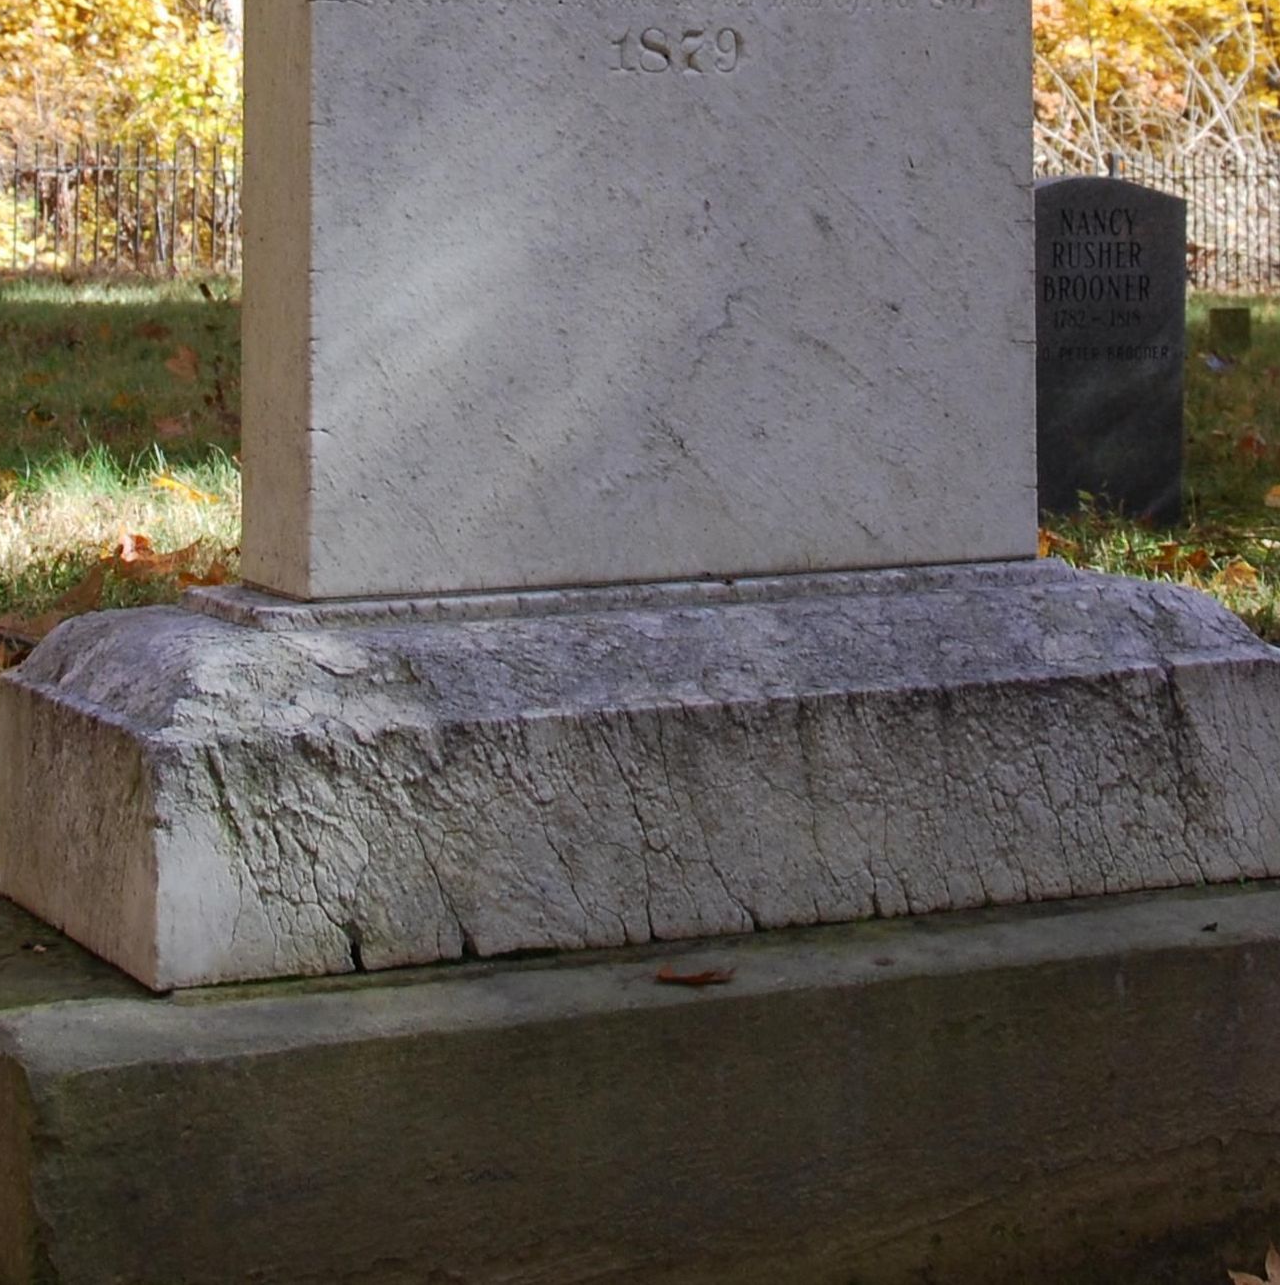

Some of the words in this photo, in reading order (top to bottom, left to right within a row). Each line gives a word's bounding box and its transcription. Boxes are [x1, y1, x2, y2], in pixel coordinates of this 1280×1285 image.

[609, 26, 744, 74] 1879
[1060, 207, 1138, 237] NANCY
[1052, 240, 1142, 269] RUSHER
[1043, 274, 1151, 303] BROONER
[1058, 345, 1100, 362] PETER
